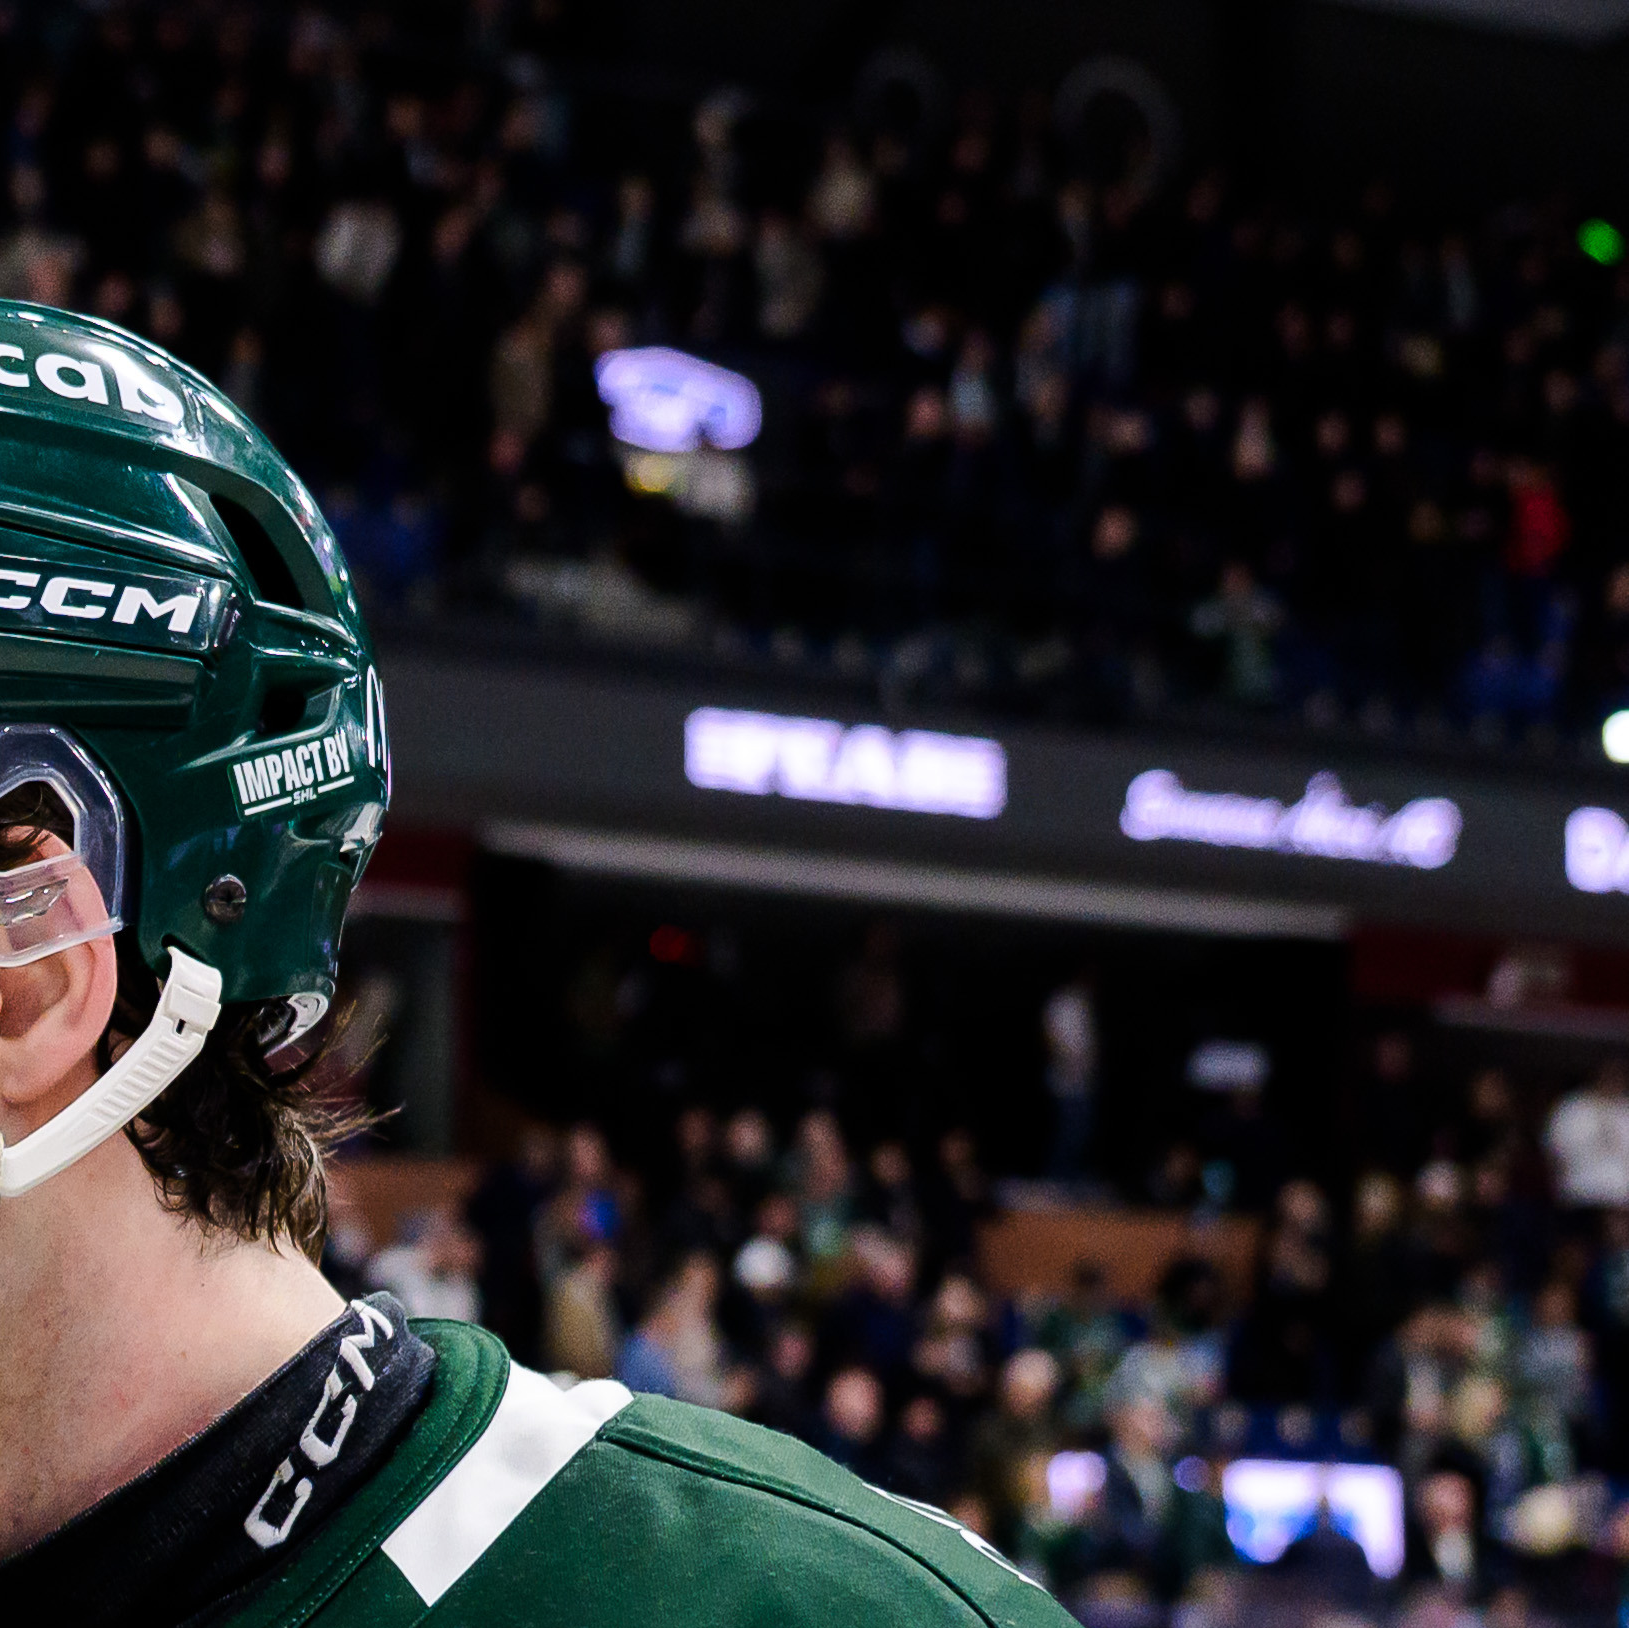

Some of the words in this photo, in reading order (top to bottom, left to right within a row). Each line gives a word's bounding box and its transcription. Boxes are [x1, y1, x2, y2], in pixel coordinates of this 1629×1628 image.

[232, 740, 325, 805] IMPACT
[323, 726, 351, 778] BY
[244, 1298, 395, 1550] CCM
